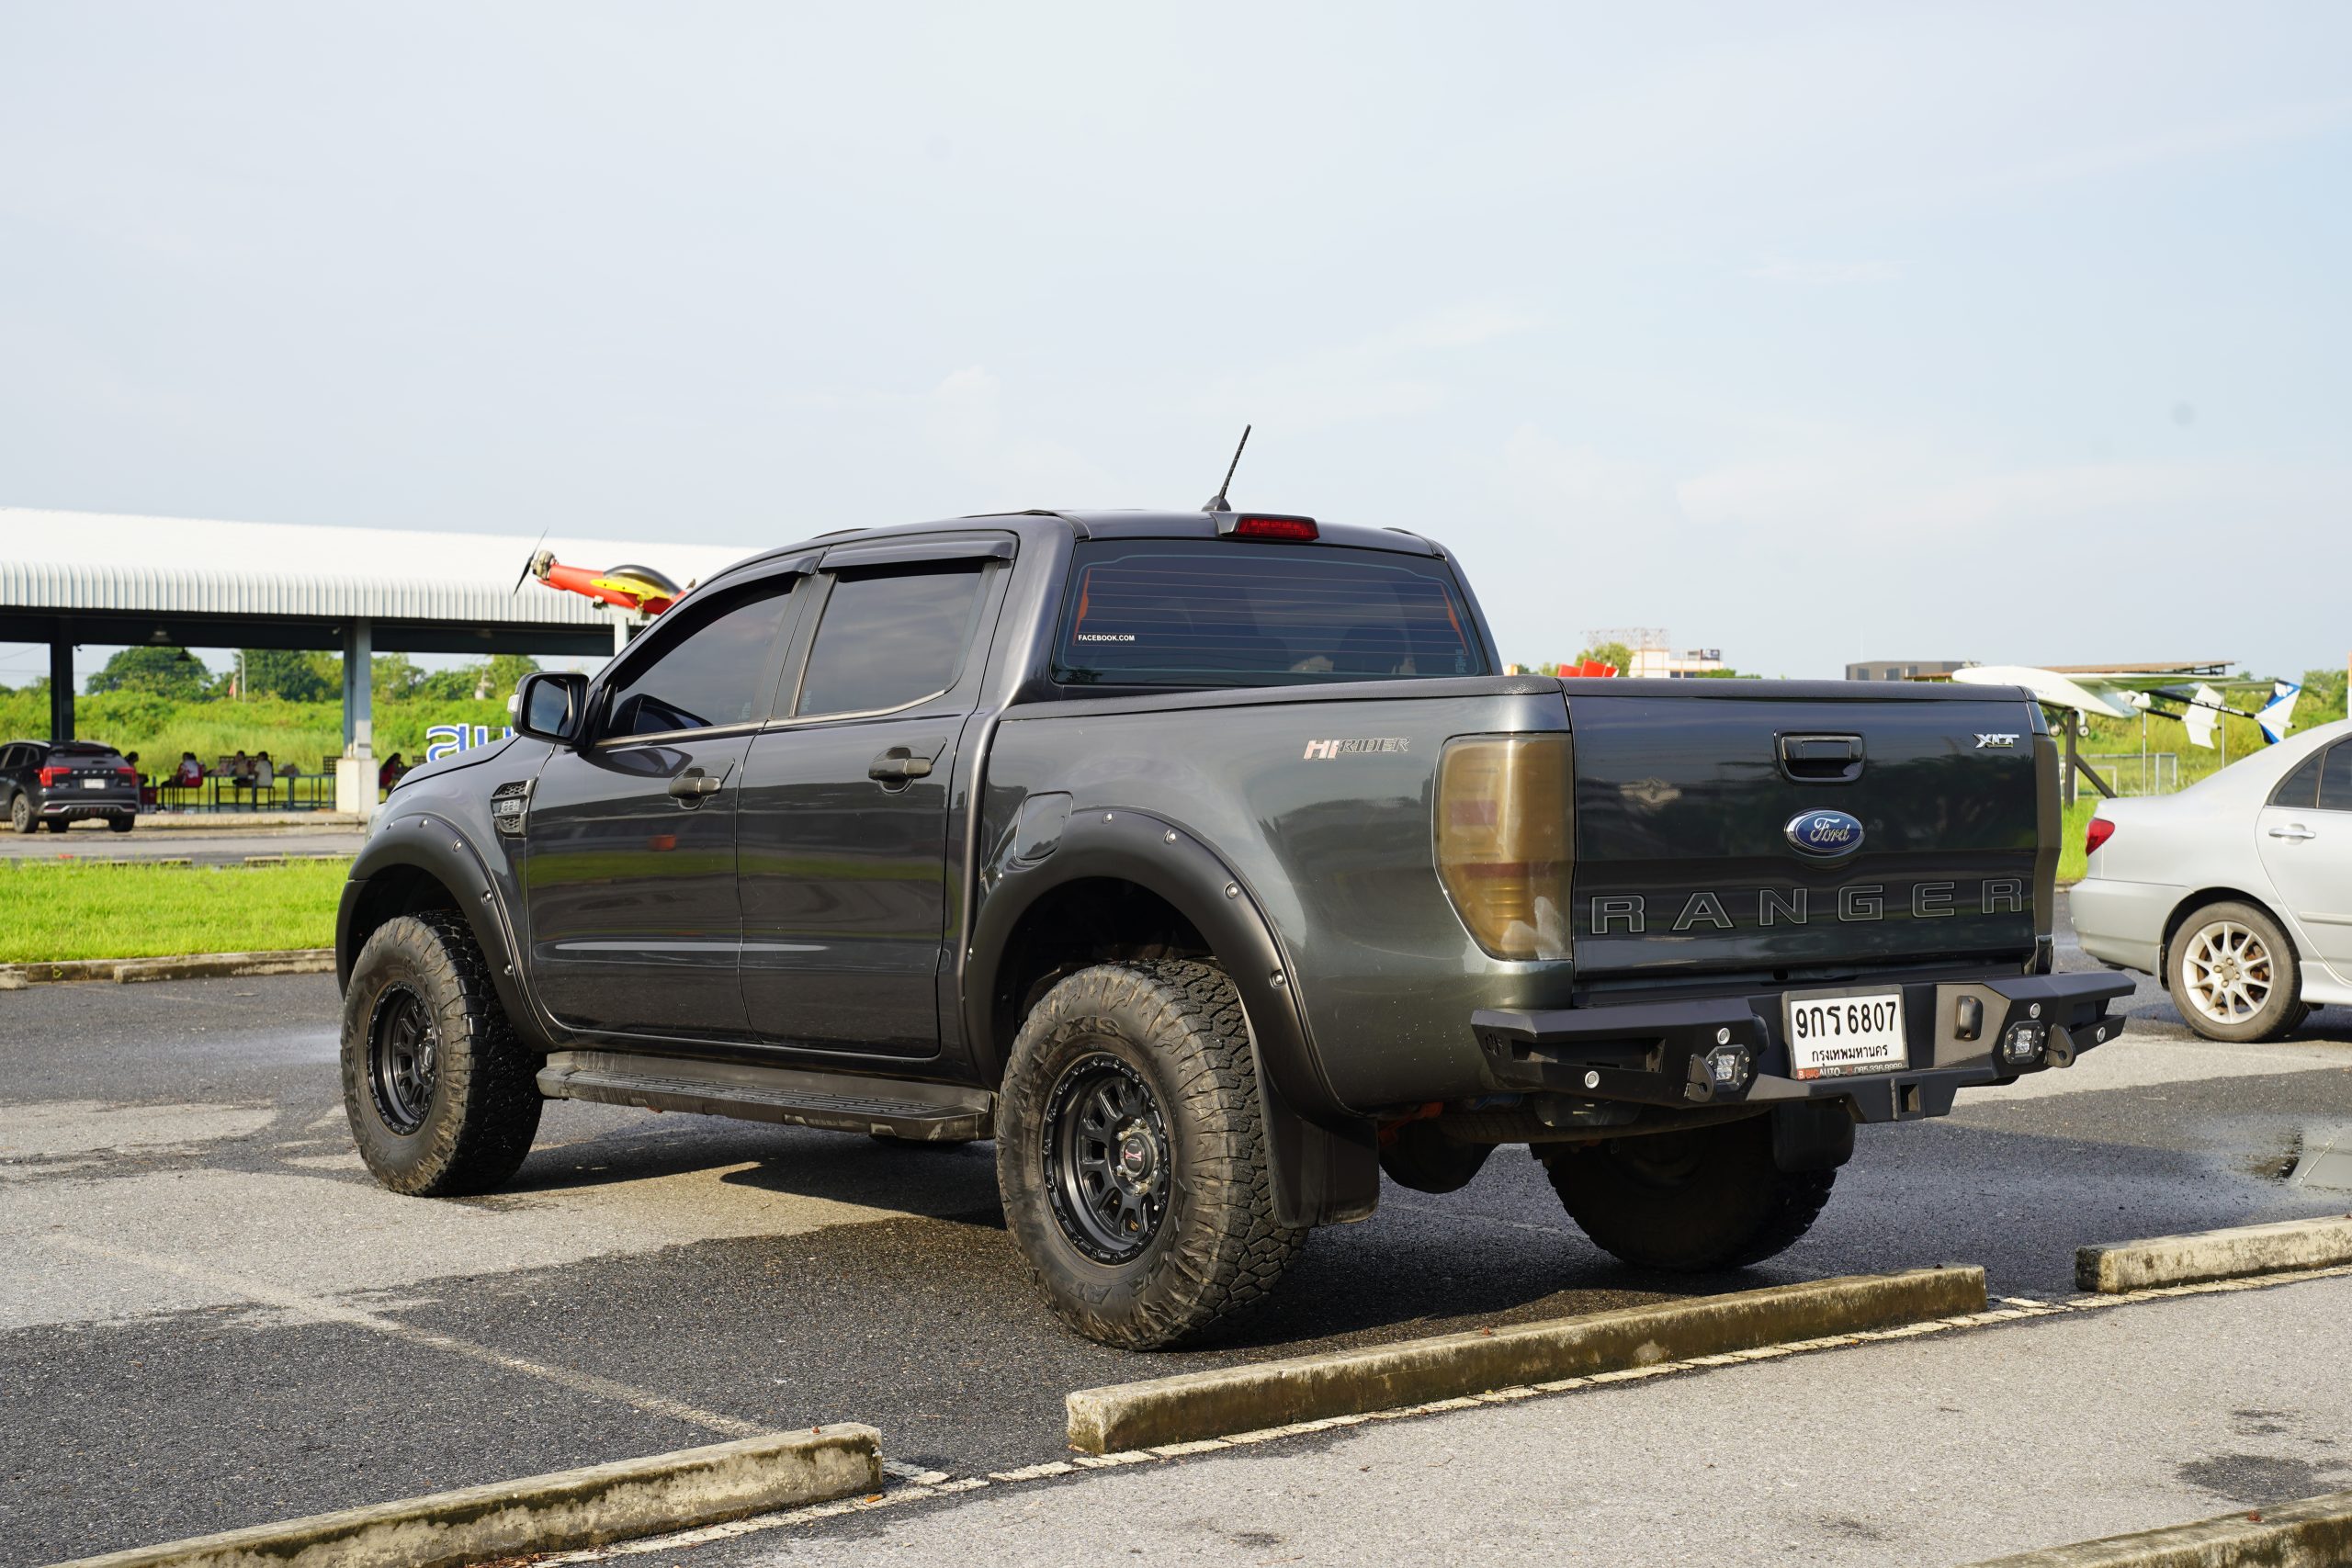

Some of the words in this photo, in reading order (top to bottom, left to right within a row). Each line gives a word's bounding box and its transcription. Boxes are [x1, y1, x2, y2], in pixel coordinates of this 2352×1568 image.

[1078, 634, 1136, 642] FACEBOOK.COM
[1973, 733, 2020, 749] XLT
[1809, 817, 1850, 843] Ford
[1589, 877, 2024, 935] RANGER
[1795, 1005, 1841, 1039] 9กร
[1847, 1001, 1896, 1034] 6807
[1811, 1043, 1889, 1066] กรุงเทพมหานคร
